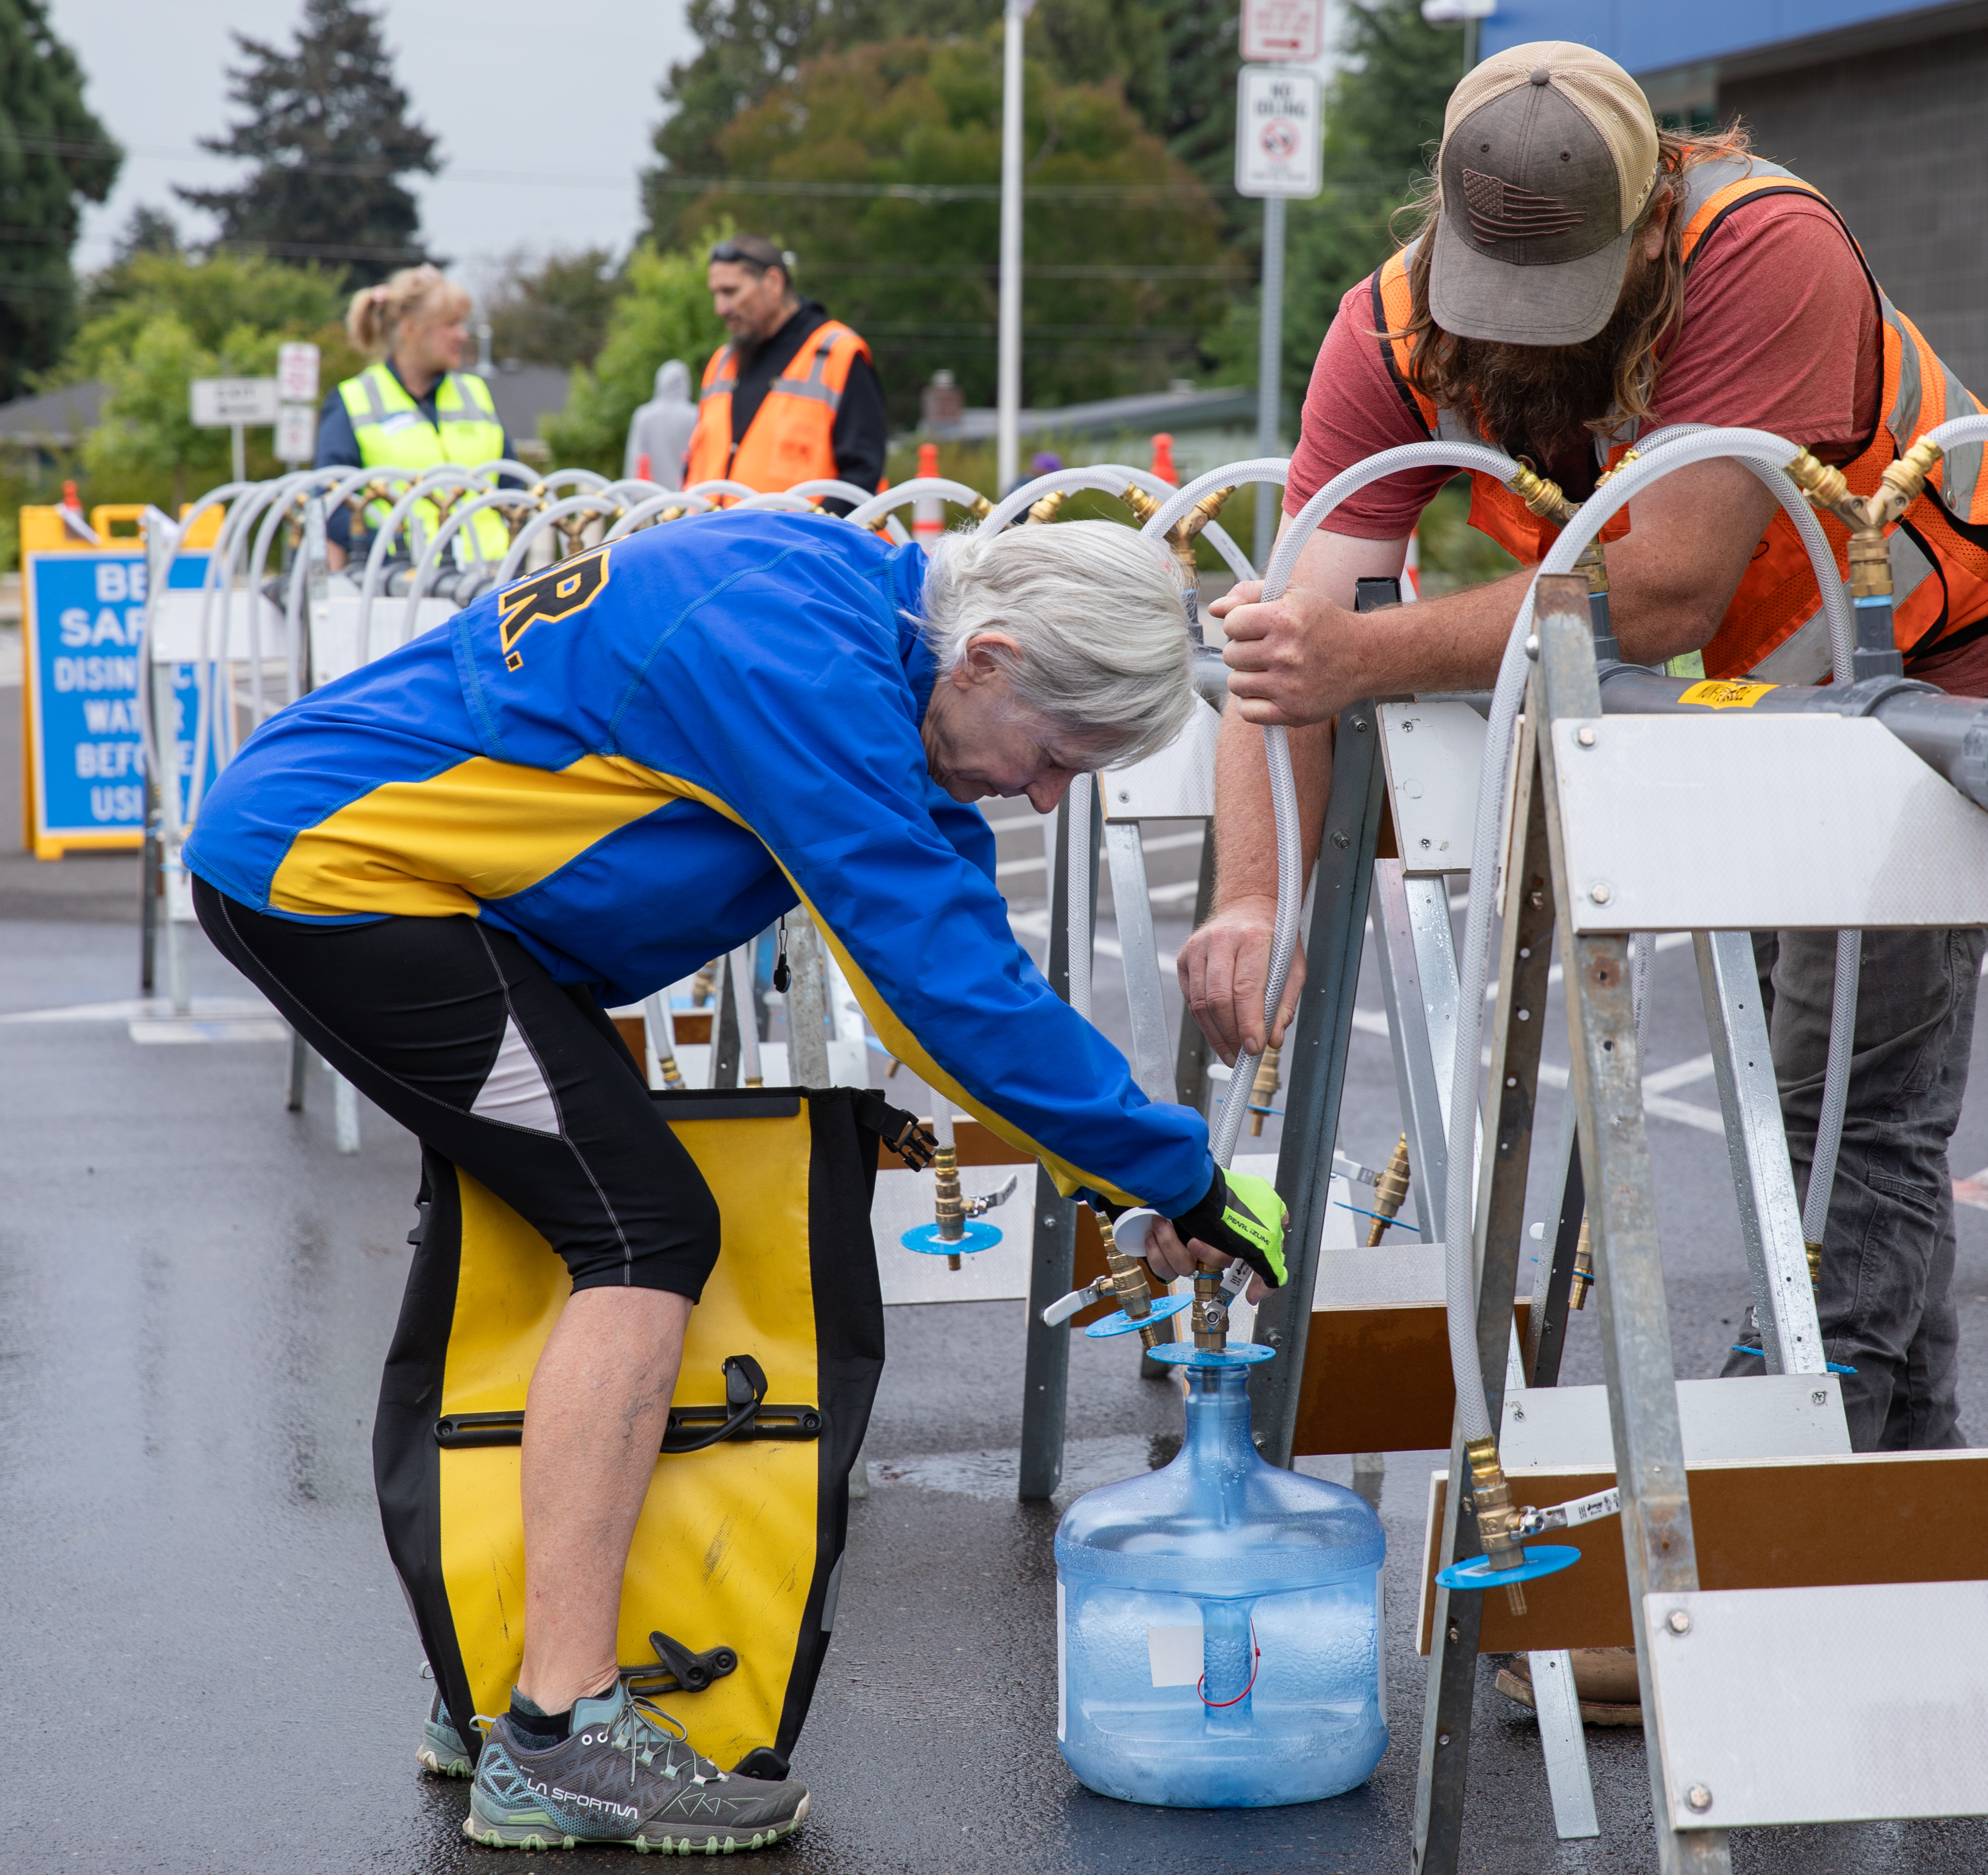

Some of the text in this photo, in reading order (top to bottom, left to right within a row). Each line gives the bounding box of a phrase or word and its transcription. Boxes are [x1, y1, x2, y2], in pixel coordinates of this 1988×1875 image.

[59, 607, 146, 647] SAF
[1227, 1215, 1248, 1232] PEARL
[526, 1777, 638, 1820] LA SPORTIVA
